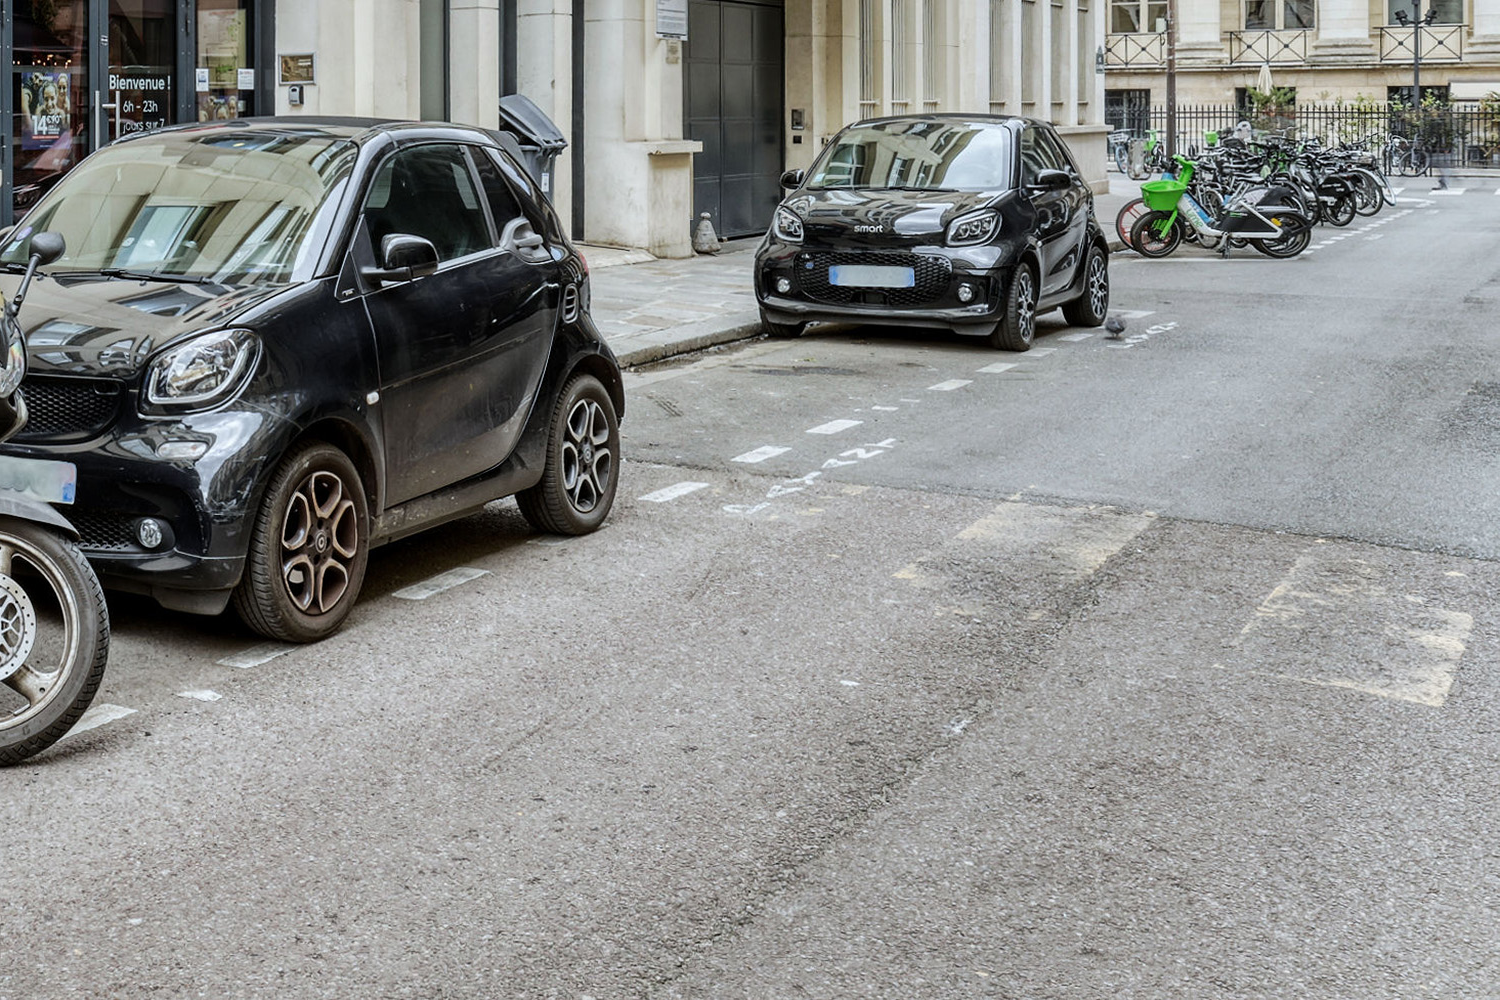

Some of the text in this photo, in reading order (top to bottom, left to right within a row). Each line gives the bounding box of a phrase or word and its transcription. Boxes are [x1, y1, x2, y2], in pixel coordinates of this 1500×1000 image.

[109, 74, 165, 90] Bienvenue
[122, 100, 134, 113] 6h
[142, 100, 158, 113] 23h
[122, 121, 144, 134] jours
[854, 224, 884, 233] smart
